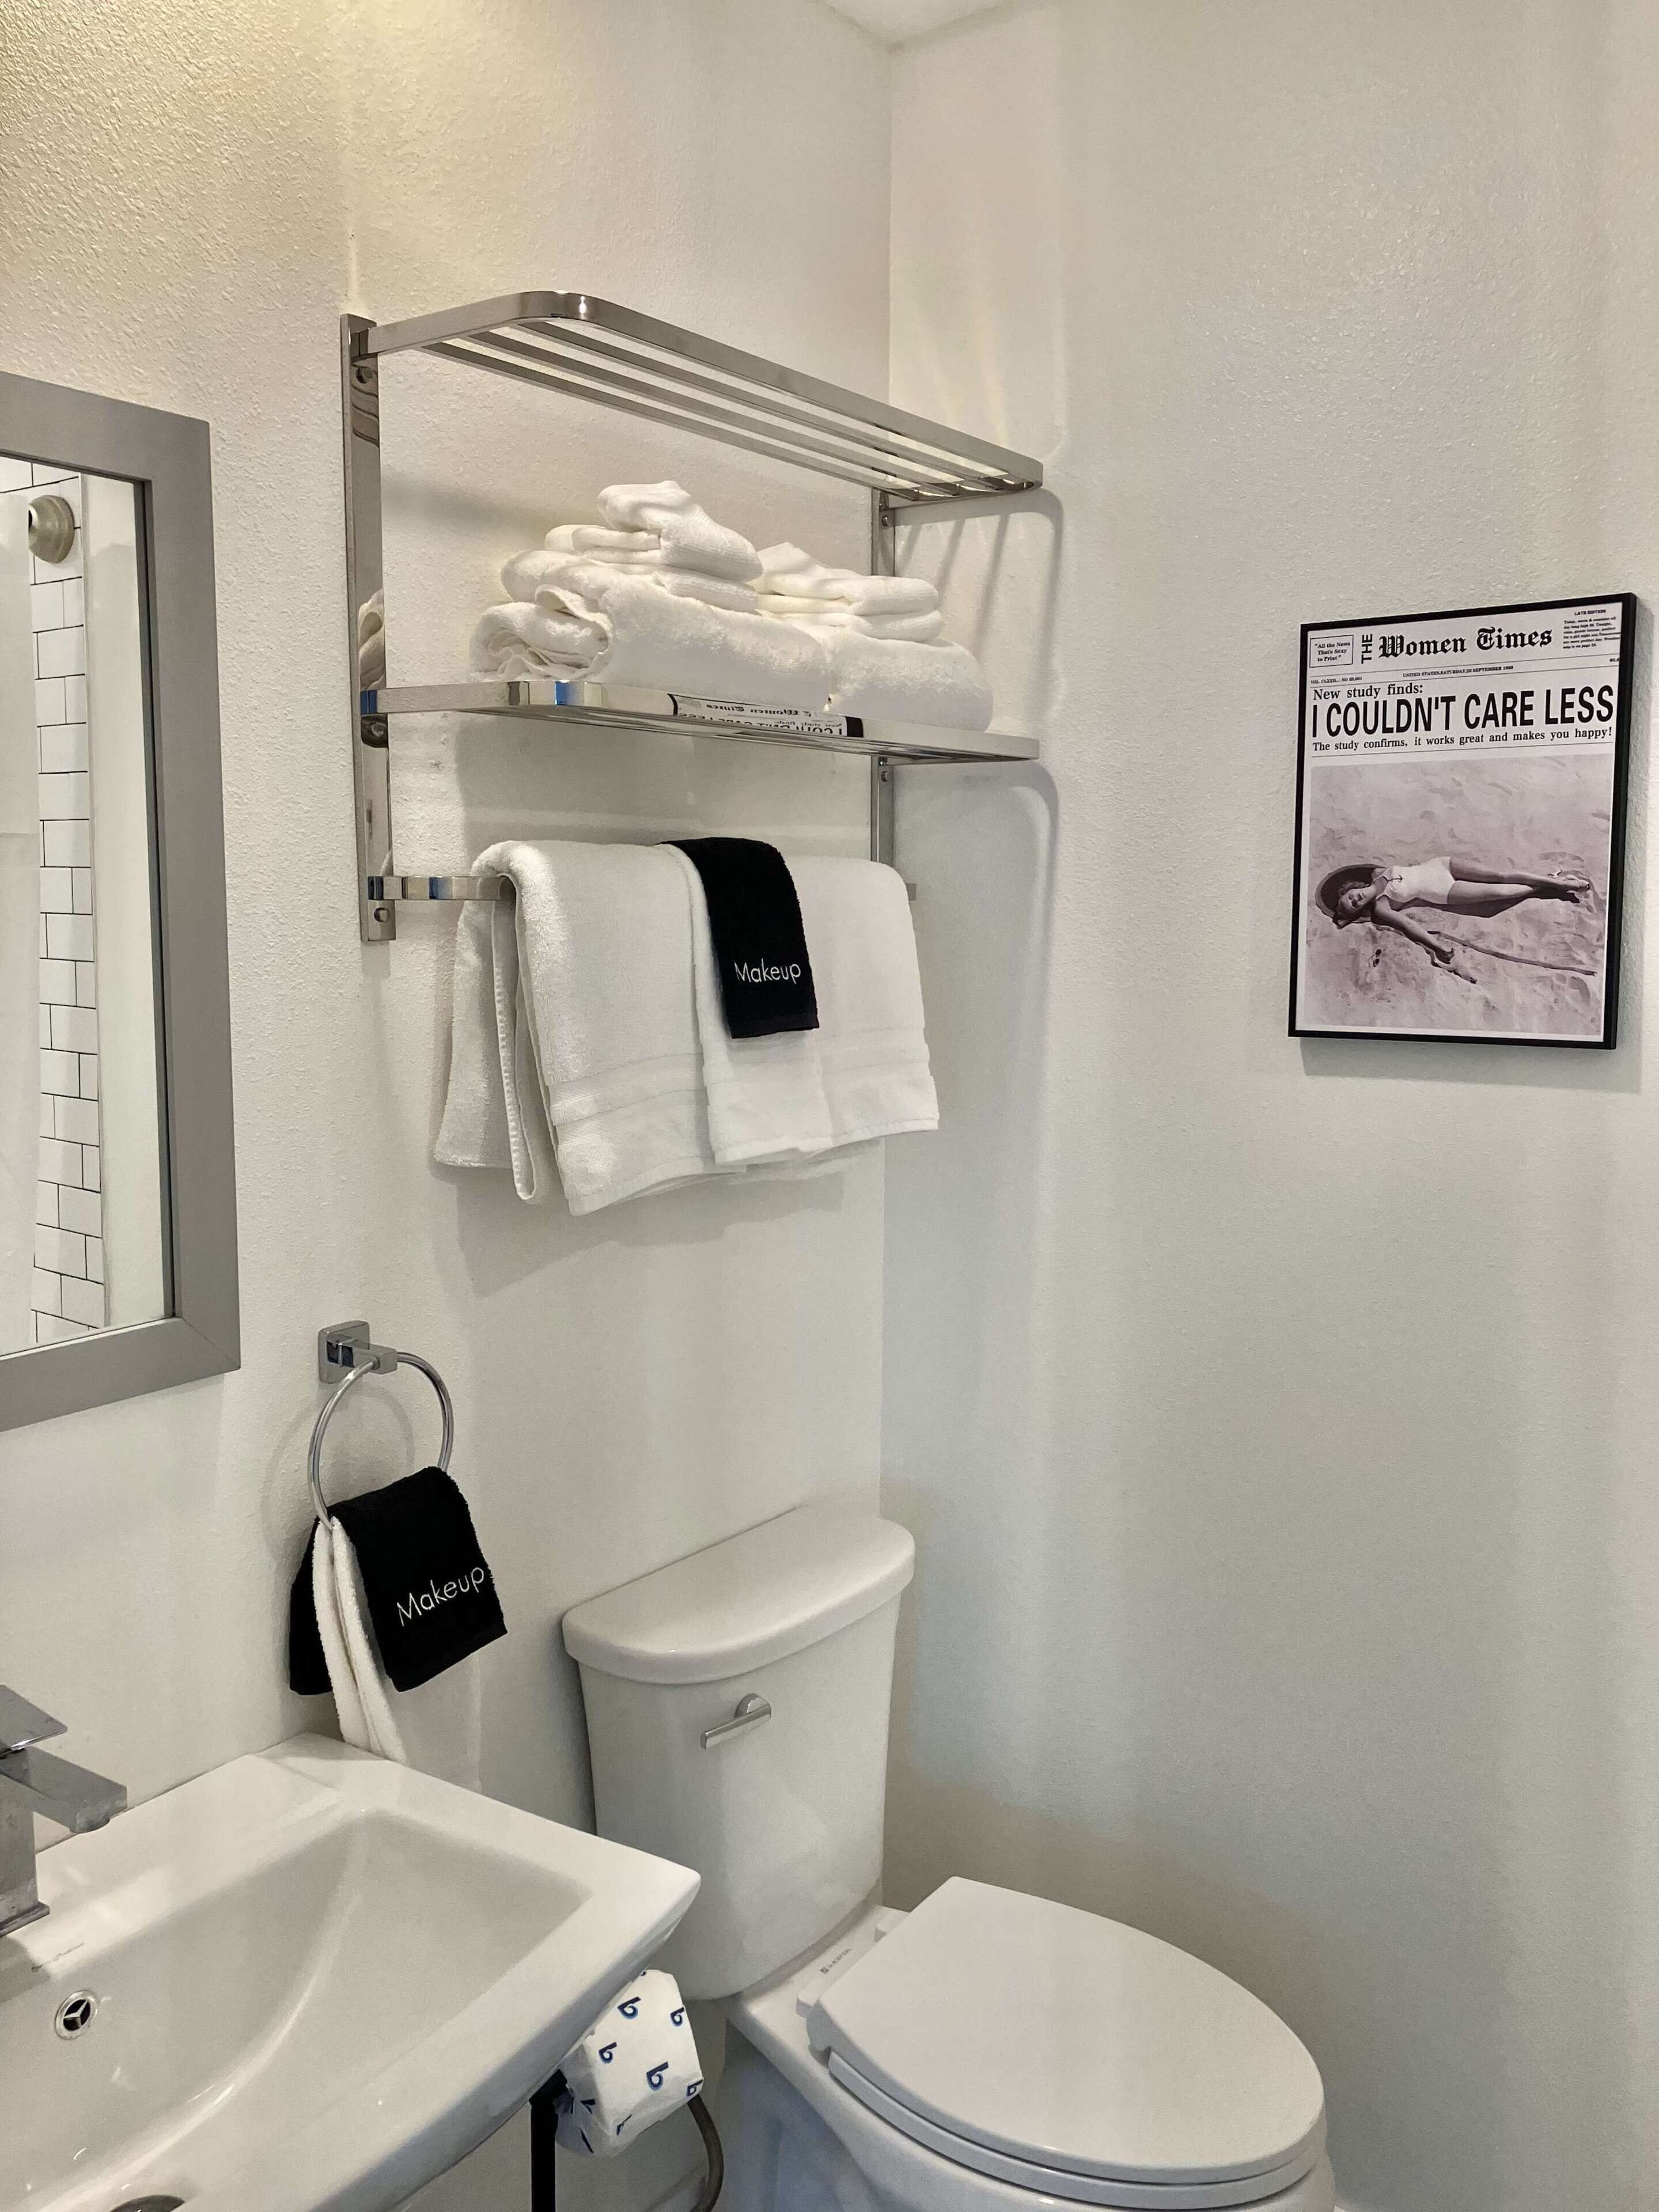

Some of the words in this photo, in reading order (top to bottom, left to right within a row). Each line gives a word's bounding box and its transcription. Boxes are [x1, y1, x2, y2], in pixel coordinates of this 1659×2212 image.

[1361, 634, 1373, 664] THE
[1378, 634, 1467, 658] Women
[1476, 626, 1552, 650] Times
[1313, 689, 1340, 700] New
[1347, 685, 1381, 699] study
[1387, 682, 1423, 695] finds:
[1312, 704, 1317, 737] I
[1326, 695, 1456, 737] COULDN'T
[1464, 690, 1535, 729] CARE
[1545, 684, 1613, 725] LESS
[1312, 741, 1330, 751] The
[1335, 740, 1359, 751] study
[1363, 738, 1408, 748] confirms,
[1414, 736, 1422, 745] it
[1426, 735, 1455, 745] works
[1459, 734, 1484, 745] great
[1489, 732, 1508, 741] and
[1513, 730, 1545, 741] makes
[1550, 731, 1569, 741] you
[1574, 726, 1612, 740] happy!
[734, 957, 801, 984] Makeup
[397, 1567, 484, 1627] Makeup
